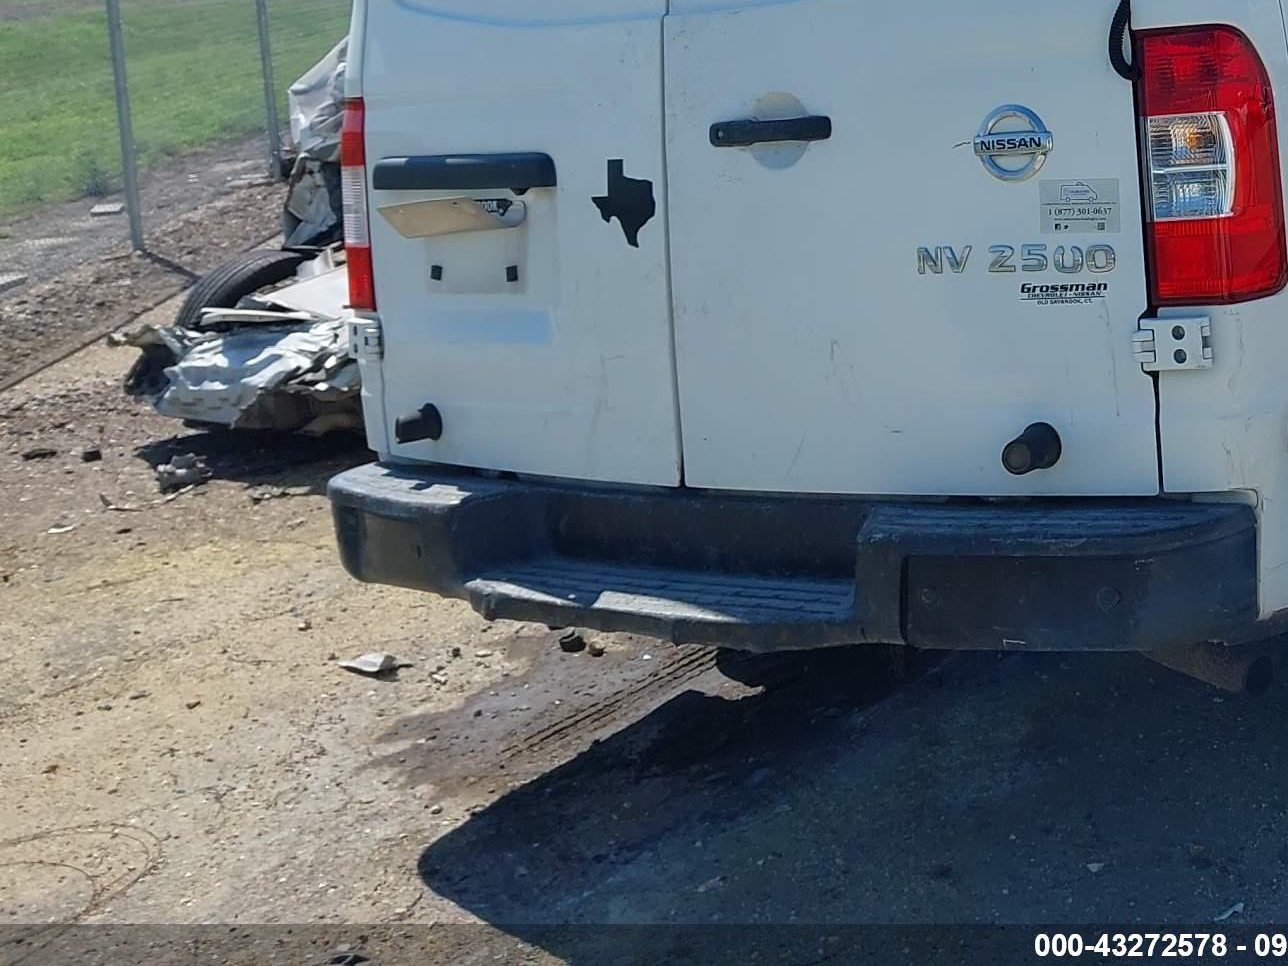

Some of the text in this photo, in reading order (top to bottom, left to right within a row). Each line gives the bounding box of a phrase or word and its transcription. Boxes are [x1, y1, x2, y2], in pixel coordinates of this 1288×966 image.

[979, 137, 1042, 151] NISSAN
[917, 244, 1116, 274] NV 2500
[1021, 283, 1108, 293] Grossman
